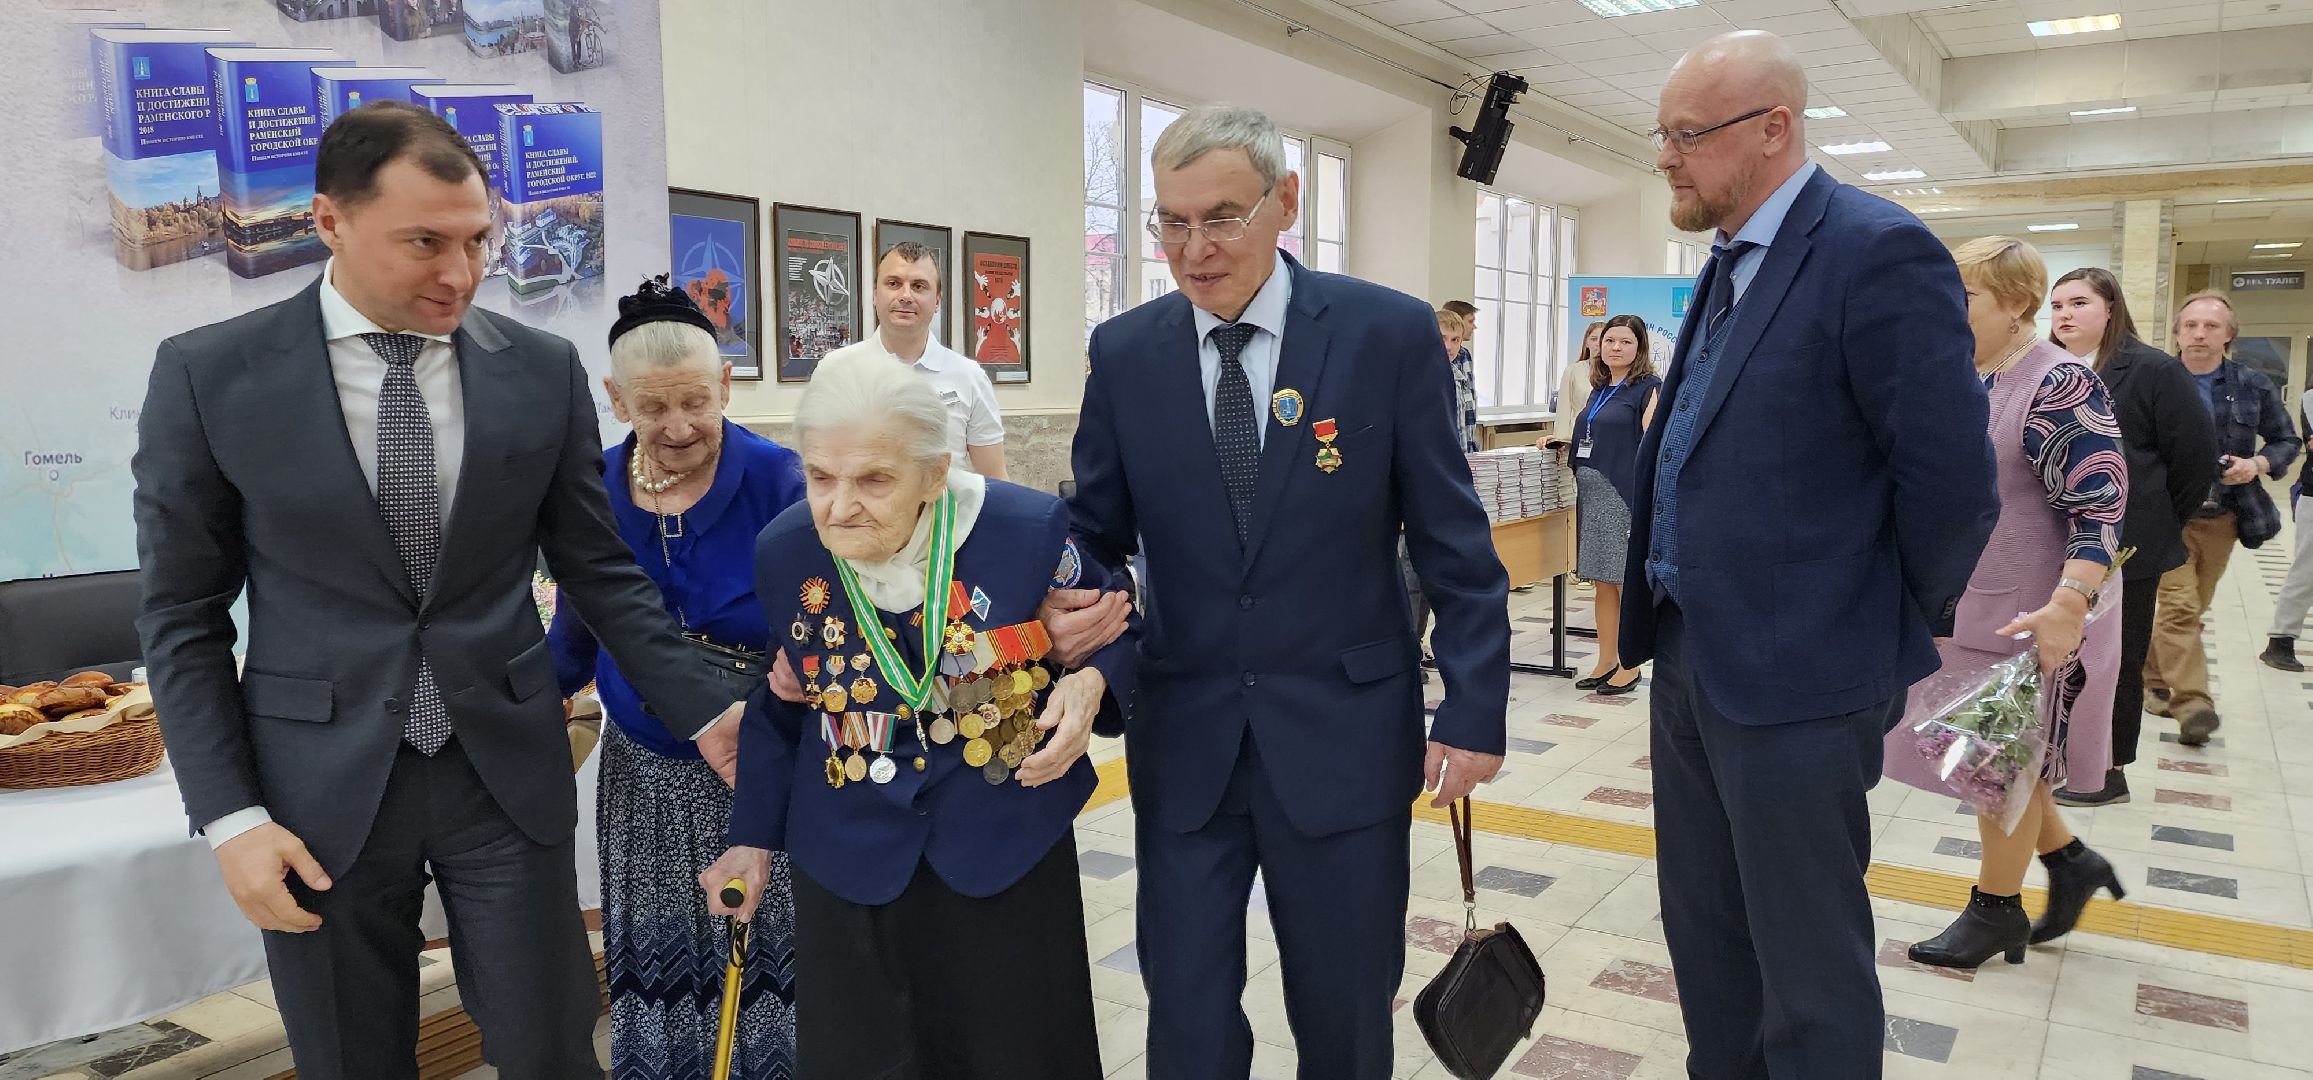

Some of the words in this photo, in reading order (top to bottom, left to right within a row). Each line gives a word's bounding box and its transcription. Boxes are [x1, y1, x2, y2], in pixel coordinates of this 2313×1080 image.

[136, 88, 171, 98] КНИГА
[172, 86, 205, 96] СЛАВЫ
[136, 102, 145, 112] И
[248, 108, 276, 118] КНИГА
[277, 106, 306, 116] СЛАВЫ
[138, 110, 204, 124] РАМЕНСКОГО
[248, 121, 256, 130] И
[249, 126, 302, 140] РАМЕНСКИЙ
[251, 137, 301, 152] ГОРОДСКОЙ
[2265, 277, 2300, 285] ТУАЛЕТ
[108, 406, 141, 420] Кли
[24, 450, 82, 466] Гомель
